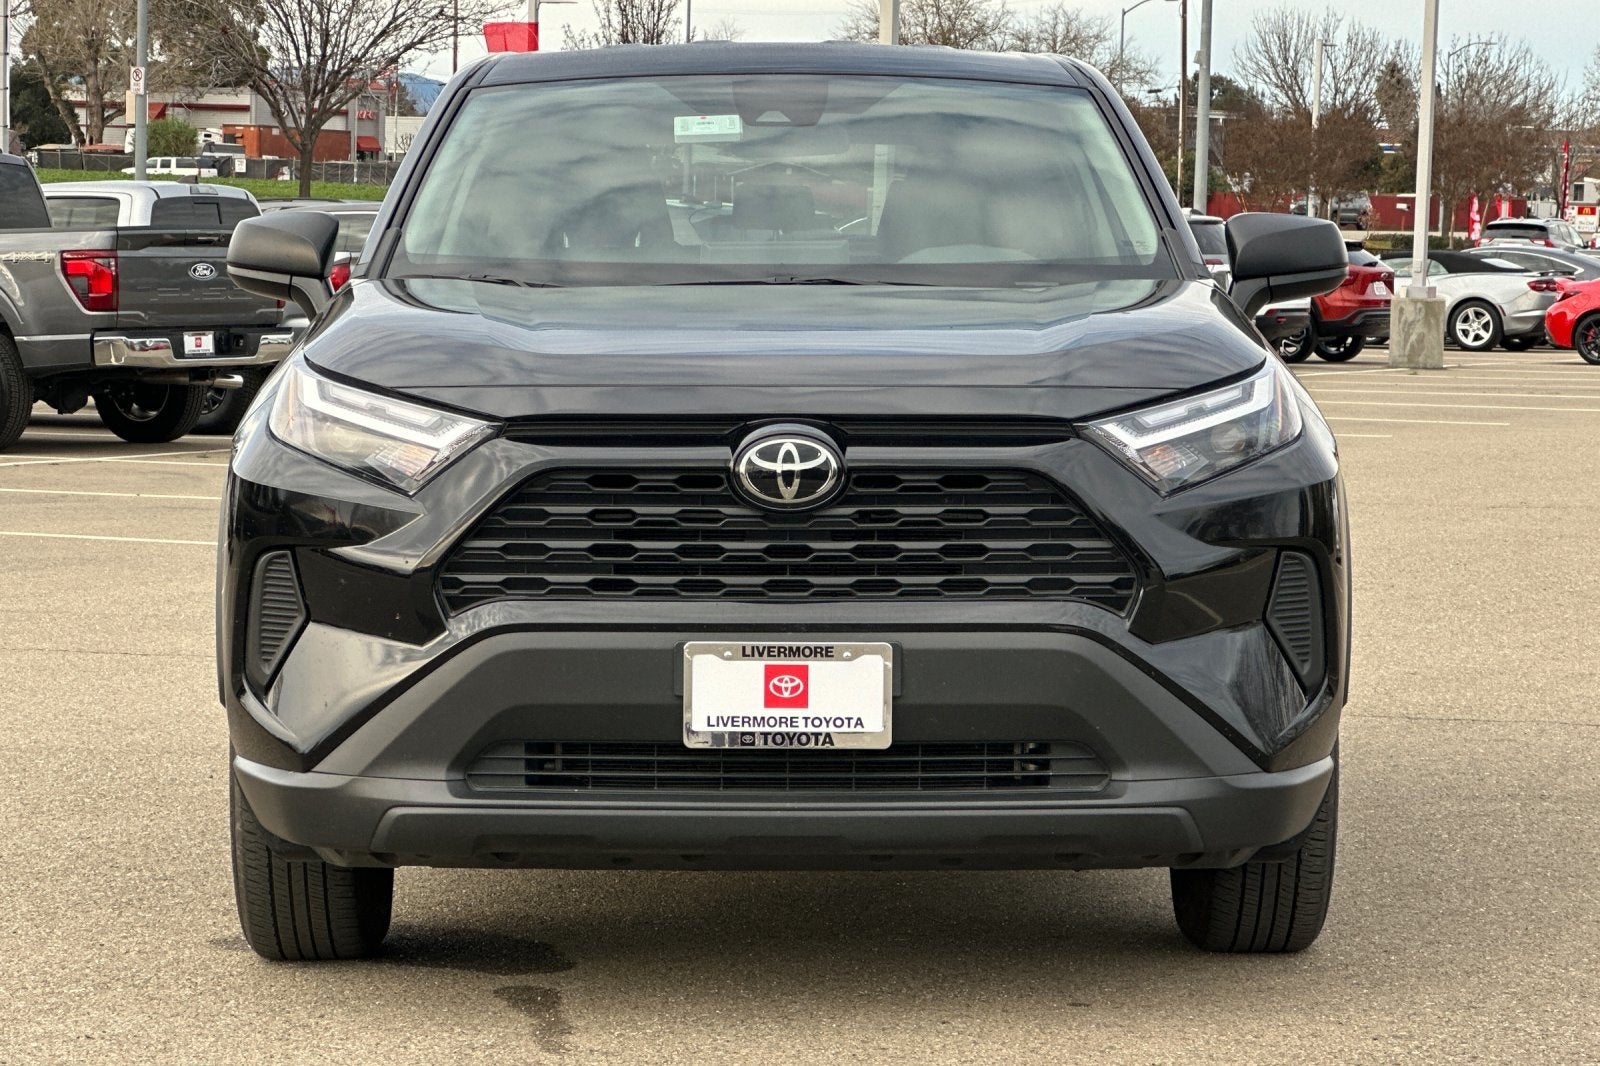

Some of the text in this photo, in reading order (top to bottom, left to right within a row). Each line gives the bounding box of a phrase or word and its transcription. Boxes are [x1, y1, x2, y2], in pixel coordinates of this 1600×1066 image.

[194, 264, 212, 277] Ford
[741, 645, 835, 659] LIVERMORE
[707, 715, 865, 729] LIVERMORE TOYOTA
[761, 732, 835, 747] TOYOTA
